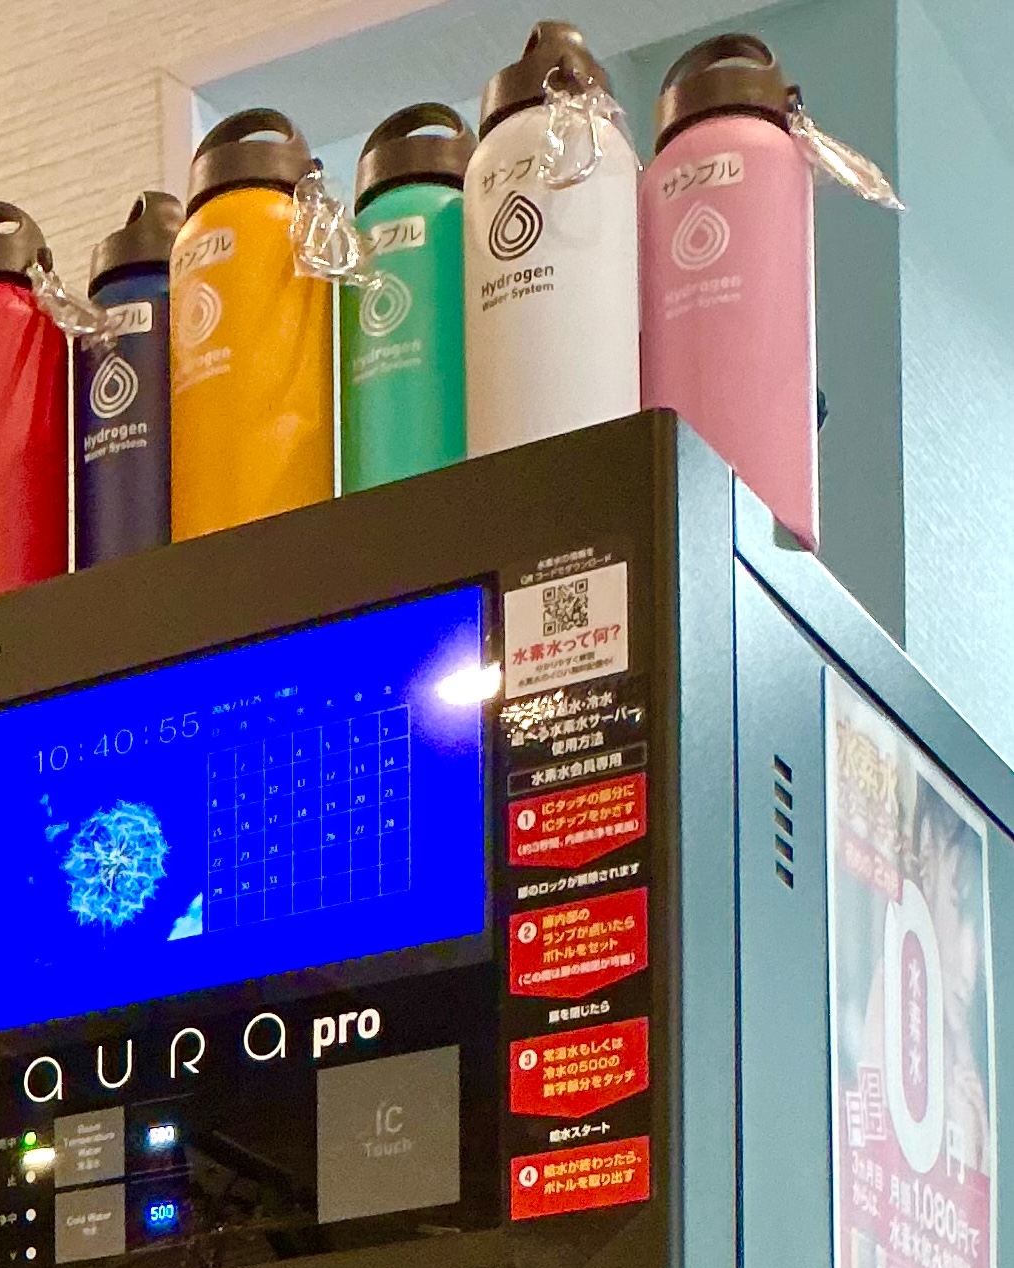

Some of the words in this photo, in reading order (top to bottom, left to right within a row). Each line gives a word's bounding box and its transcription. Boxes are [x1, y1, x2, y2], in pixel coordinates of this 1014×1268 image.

[481, 265, 554, 298] Hydrogen
[512, 282, 554, 299] System
[665, 275, 742, 304] Hydrogen
[84, 422, 147, 451] Hydrogen
[108, 438, 147, 453] System
[512, 624, 621, 665] 水素水って何?
[383, 727, 389, 736] 7
[551, 731, 604, 756] 使用方法
[541, 782, 635, 816] ICタッチの部分に
[541, 801, 636, 832] ICチップをかざす
[543, 937, 618, 963] ボトルをセット
[313, 1007, 382, 1059] pro
[524, 1054, 532, 1066] 3
[543, 1037, 624, 1062] 常温水もしくは
[543, 1055, 620, 1080] 冷水の500の
[543, 1070, 636, 1098] 数字部分をタッチ
[376, 1103, 403, 1136] IC
[549, 1122, 611, 1143] 給水スタート
[364, 1137, 413, 1157] Touch
[524, 1169, 532, 1182] 4
[544, 1169, 636, 1194] ボトルを取り出す
[149, 1203, 174, 1221] 500
